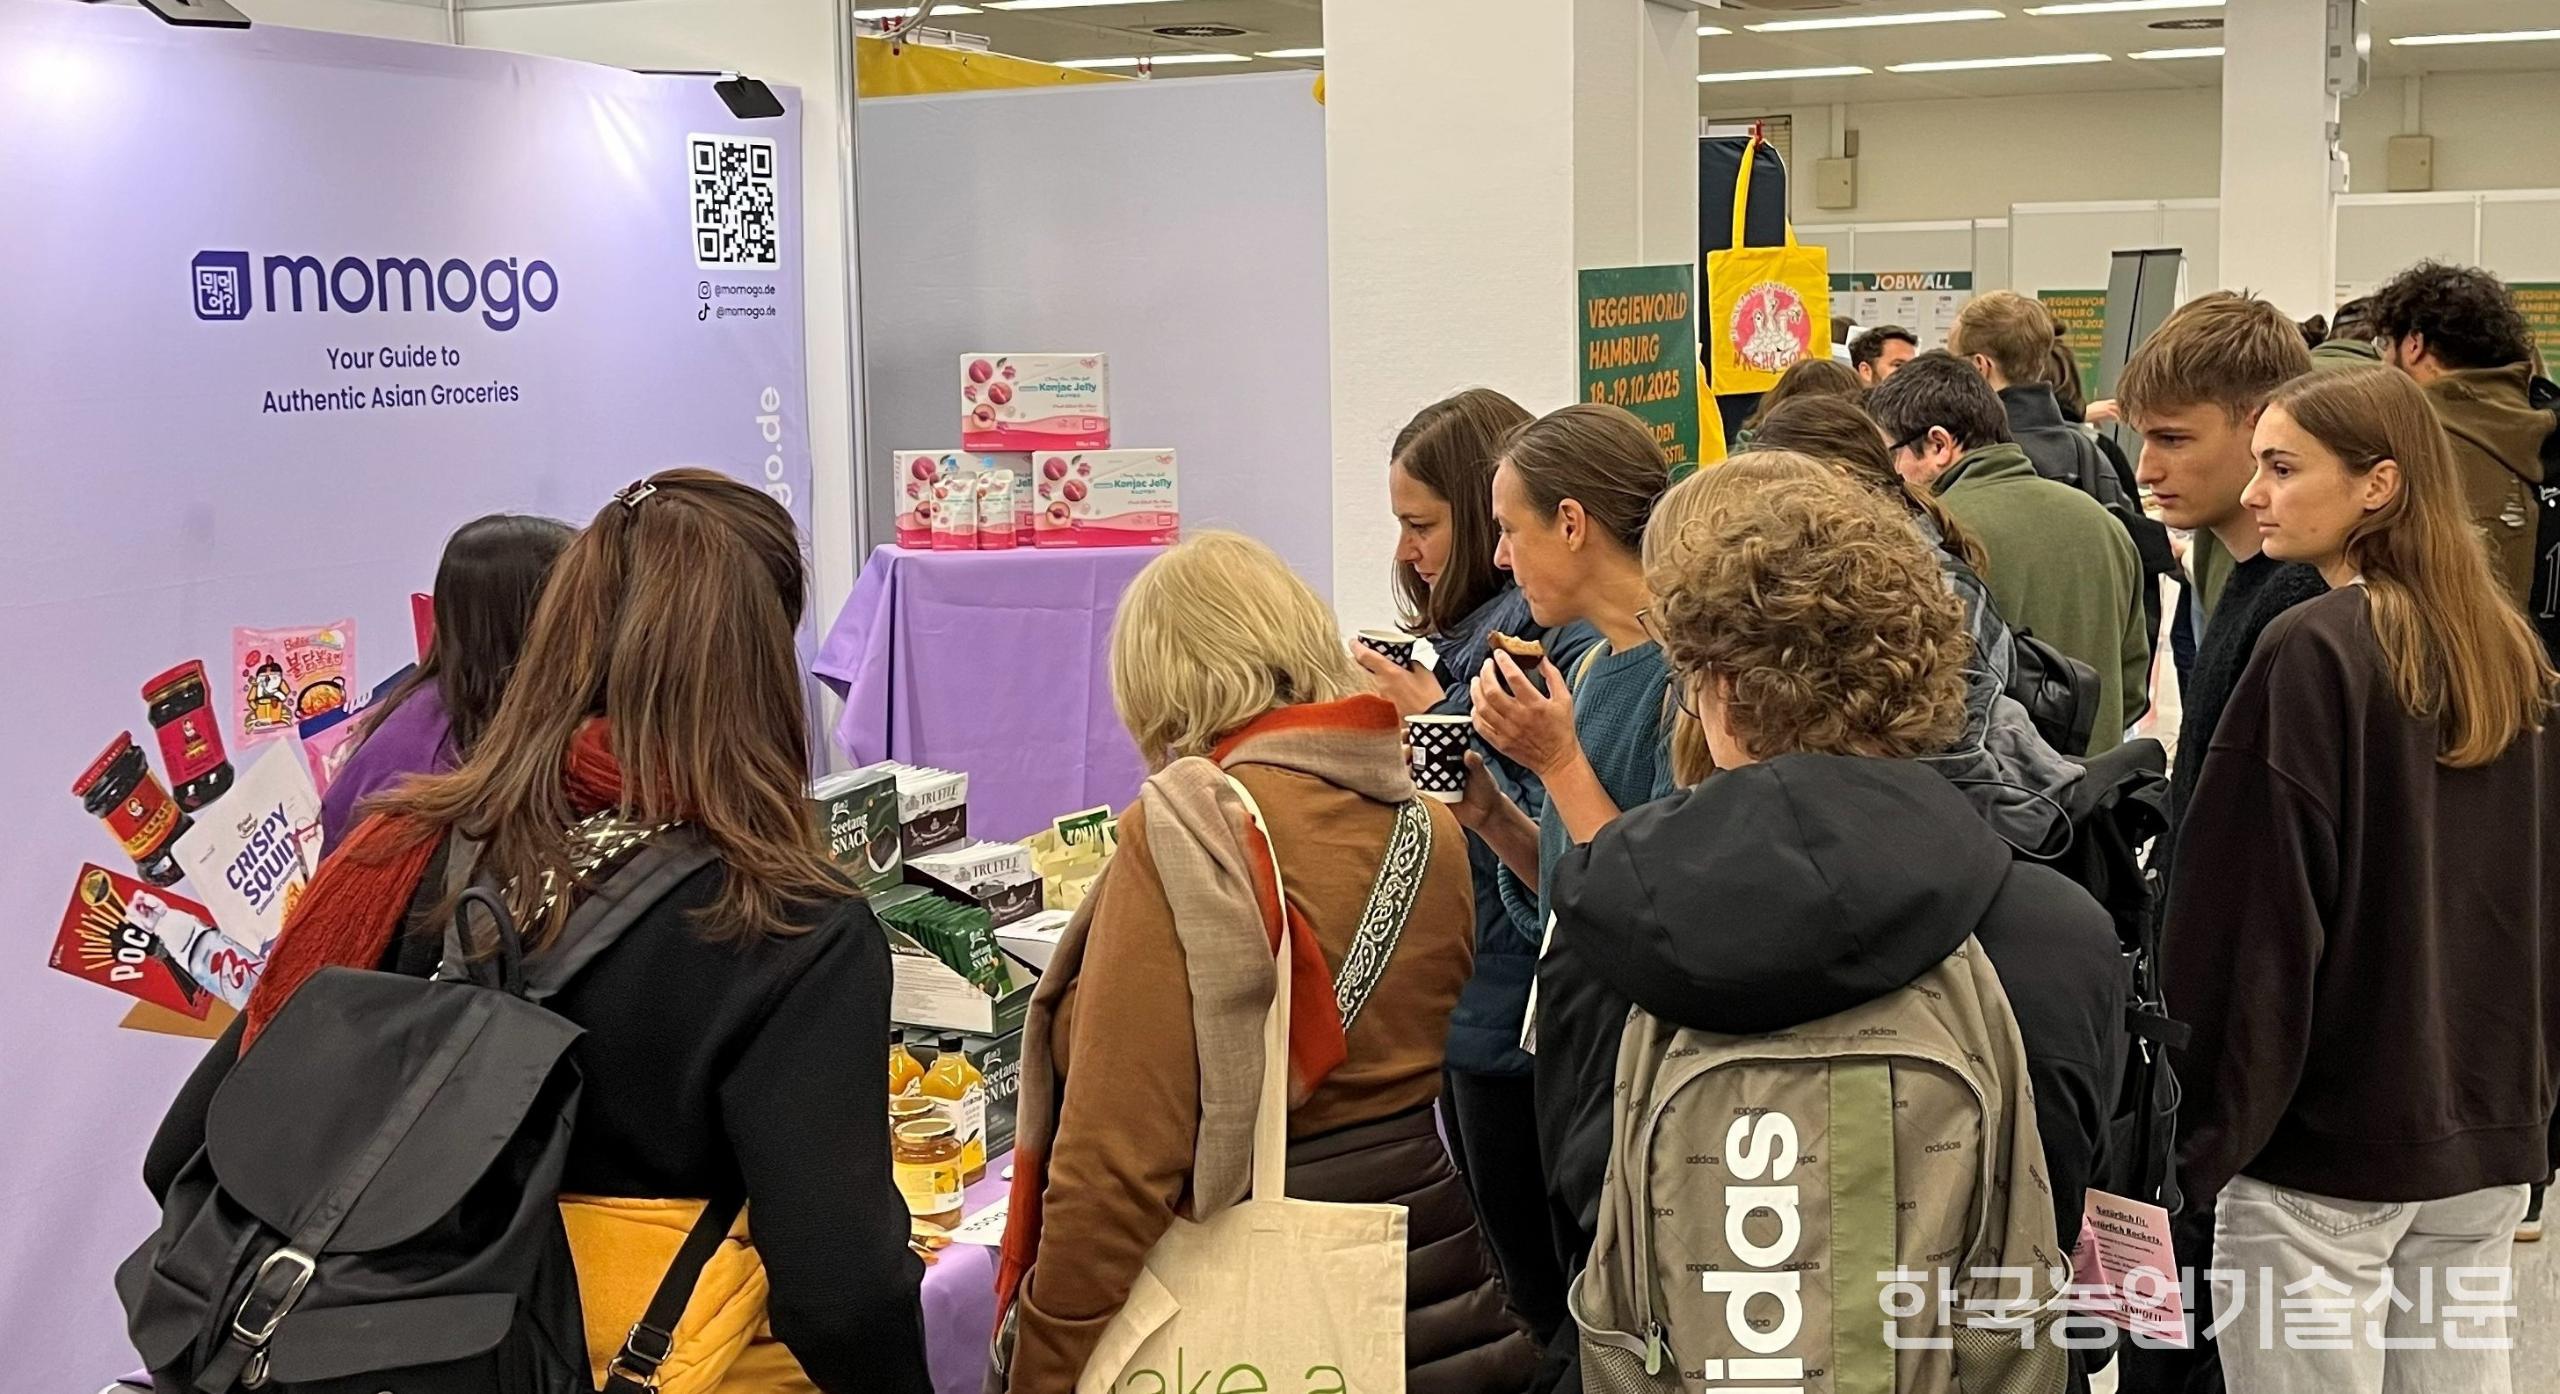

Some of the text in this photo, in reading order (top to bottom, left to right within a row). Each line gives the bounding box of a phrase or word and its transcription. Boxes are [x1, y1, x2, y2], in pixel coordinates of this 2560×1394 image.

[263, 255, 558, 331] momogo
[715, 284, 775, 297] @momogo.de
[1870, 274, 1953, 291] JOBWALL
[716, 306, 776, 319] @momogo.de
[1588, 292, 1688, 328] VEGGIEWORLD
[326, 345, 460, 370] Your Guide to
[1589, 333, 1660, 370] HAMBURG
[262, 381, 519, 413] Authentic Asian Groceries
[831, 813, 868, 838] Seetang
[226, 802, 289, 890] CRISPY
[832, 828, 869, 856] SNACK
[110, 928, 150, 982] POC
[1664, 1047, 1699, 1060] adidas
[1686, 1154, 1719, 1165] adidas
[1925, 1141, 1961, 1153] adidas
[1783, 1261, 1820, 1272] adidas
